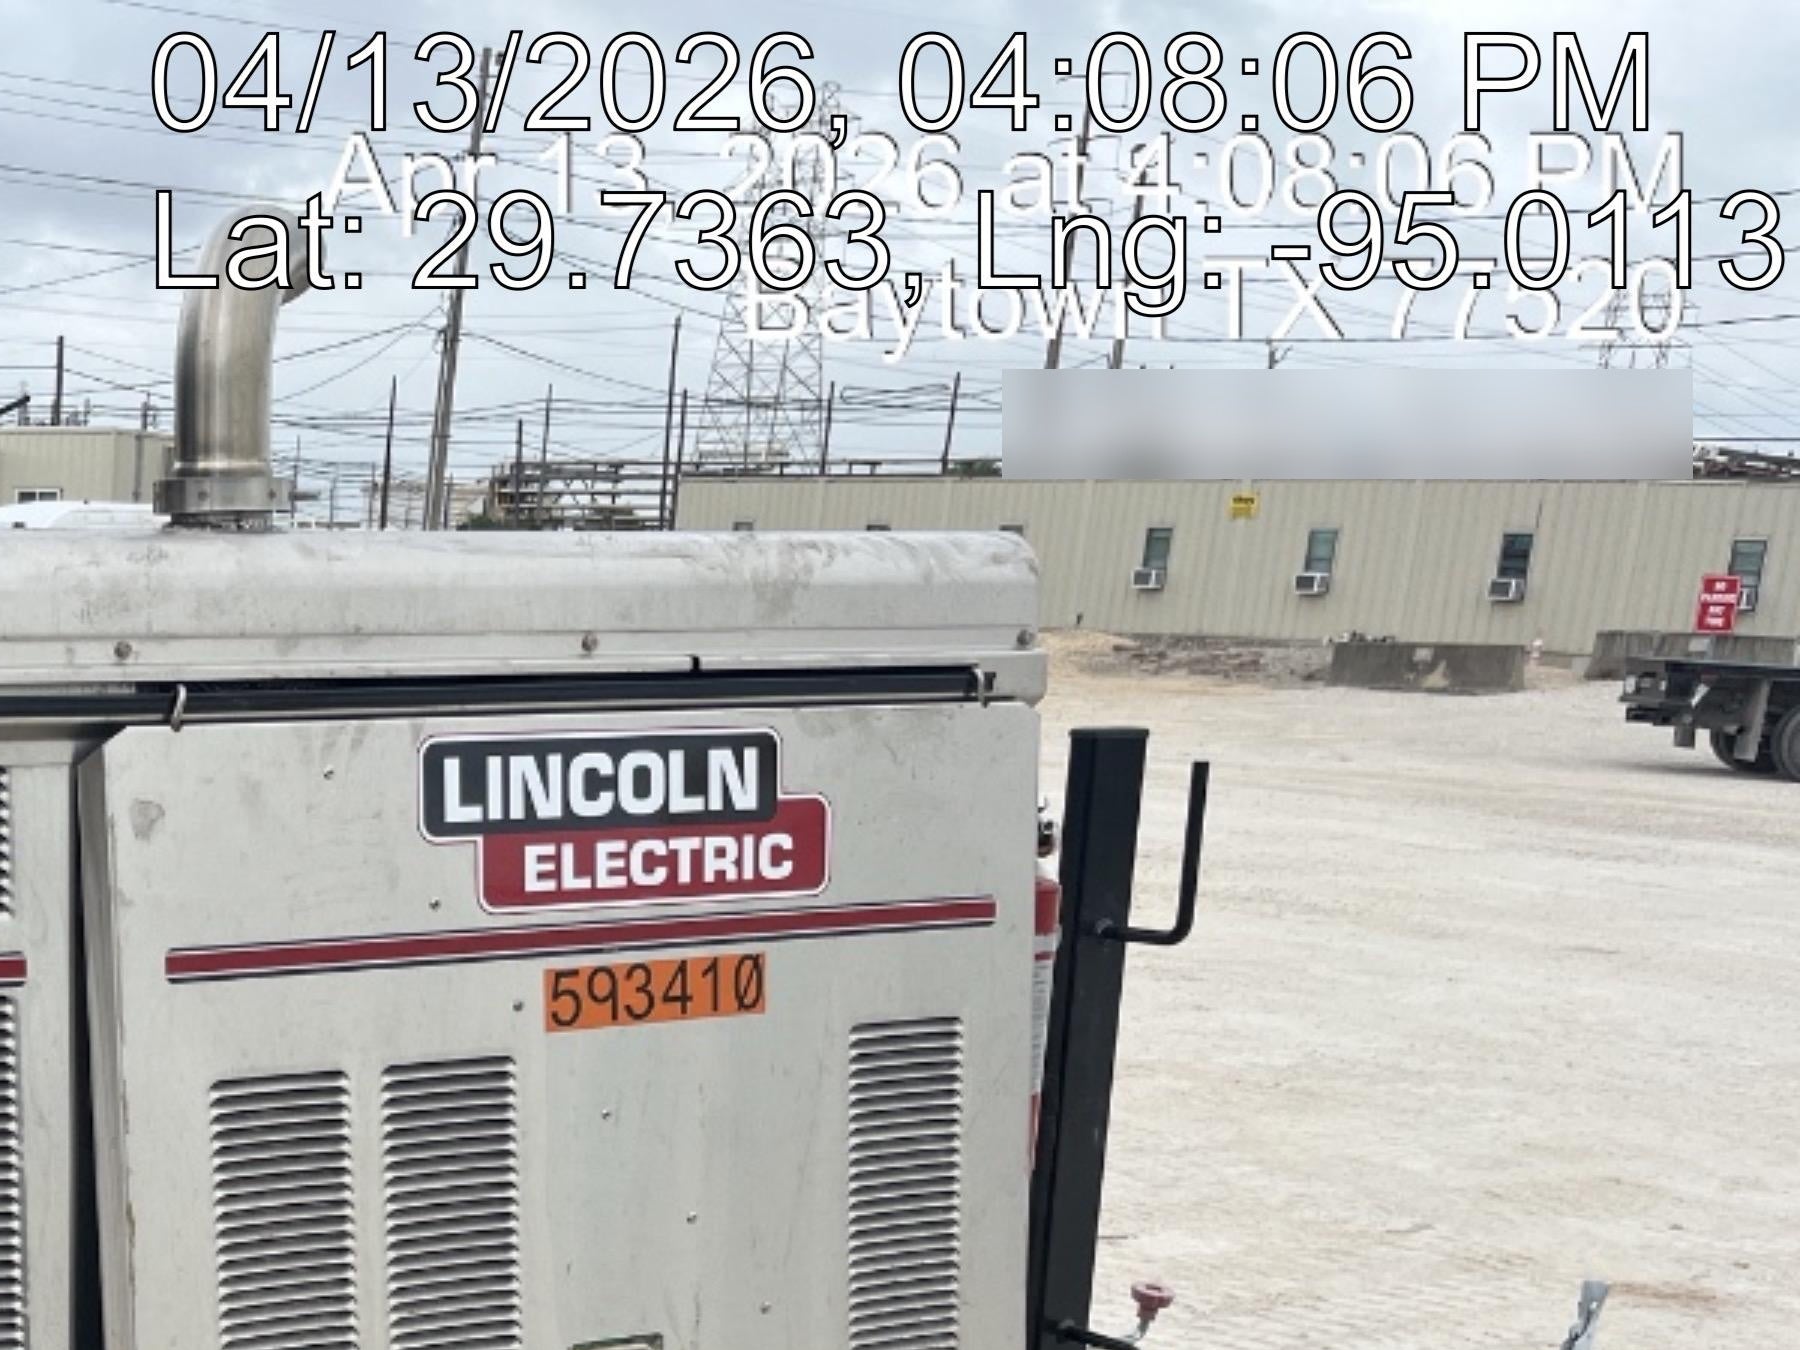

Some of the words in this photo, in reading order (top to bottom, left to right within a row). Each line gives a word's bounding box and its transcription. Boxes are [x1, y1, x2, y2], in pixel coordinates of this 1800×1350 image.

[443, 746, 760, 823] LINCOLN
[523, 832, 794, 893] ELECTRIC
[550, 953, 764, 1028] 593410
